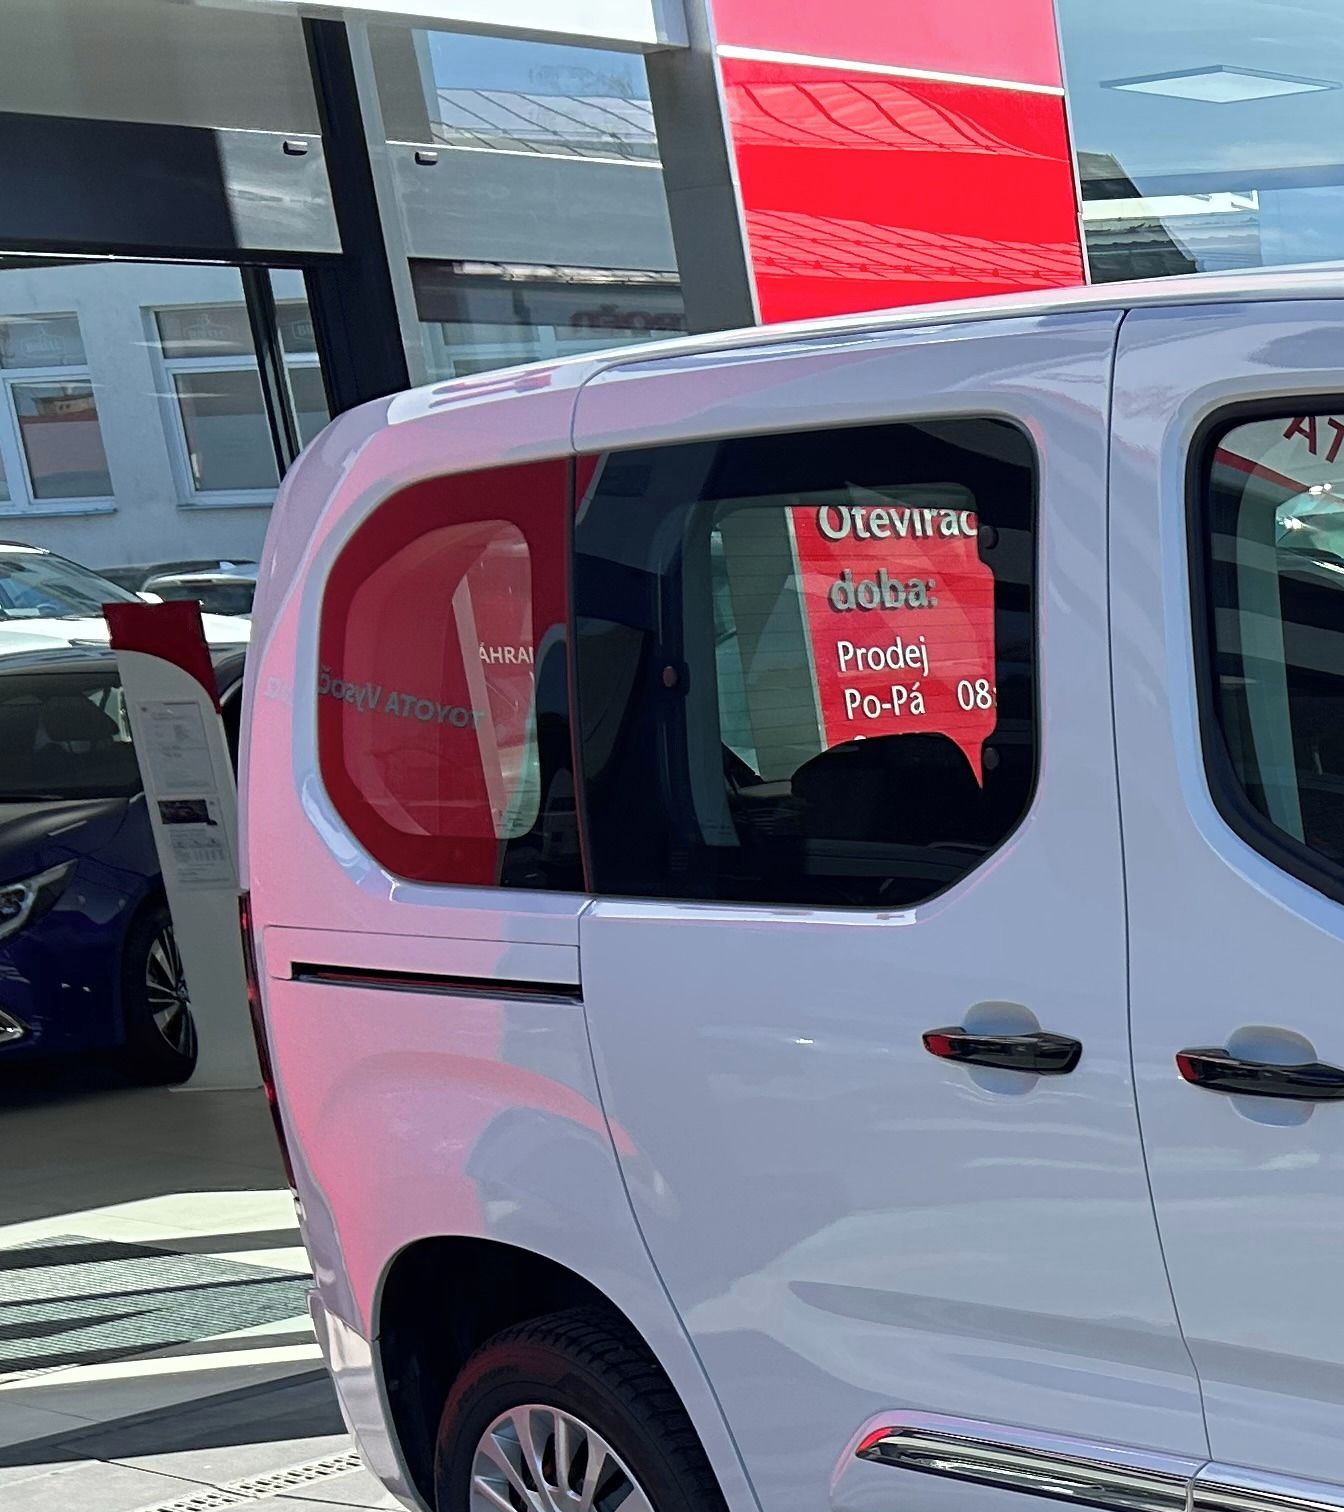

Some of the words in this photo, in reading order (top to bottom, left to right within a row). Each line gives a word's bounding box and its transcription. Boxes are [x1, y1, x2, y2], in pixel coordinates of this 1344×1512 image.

[830, 568, 938, 610] doba:
[837, 636, 929, 676] Prodej
[844, 681, 926, 720] Po-Pá
